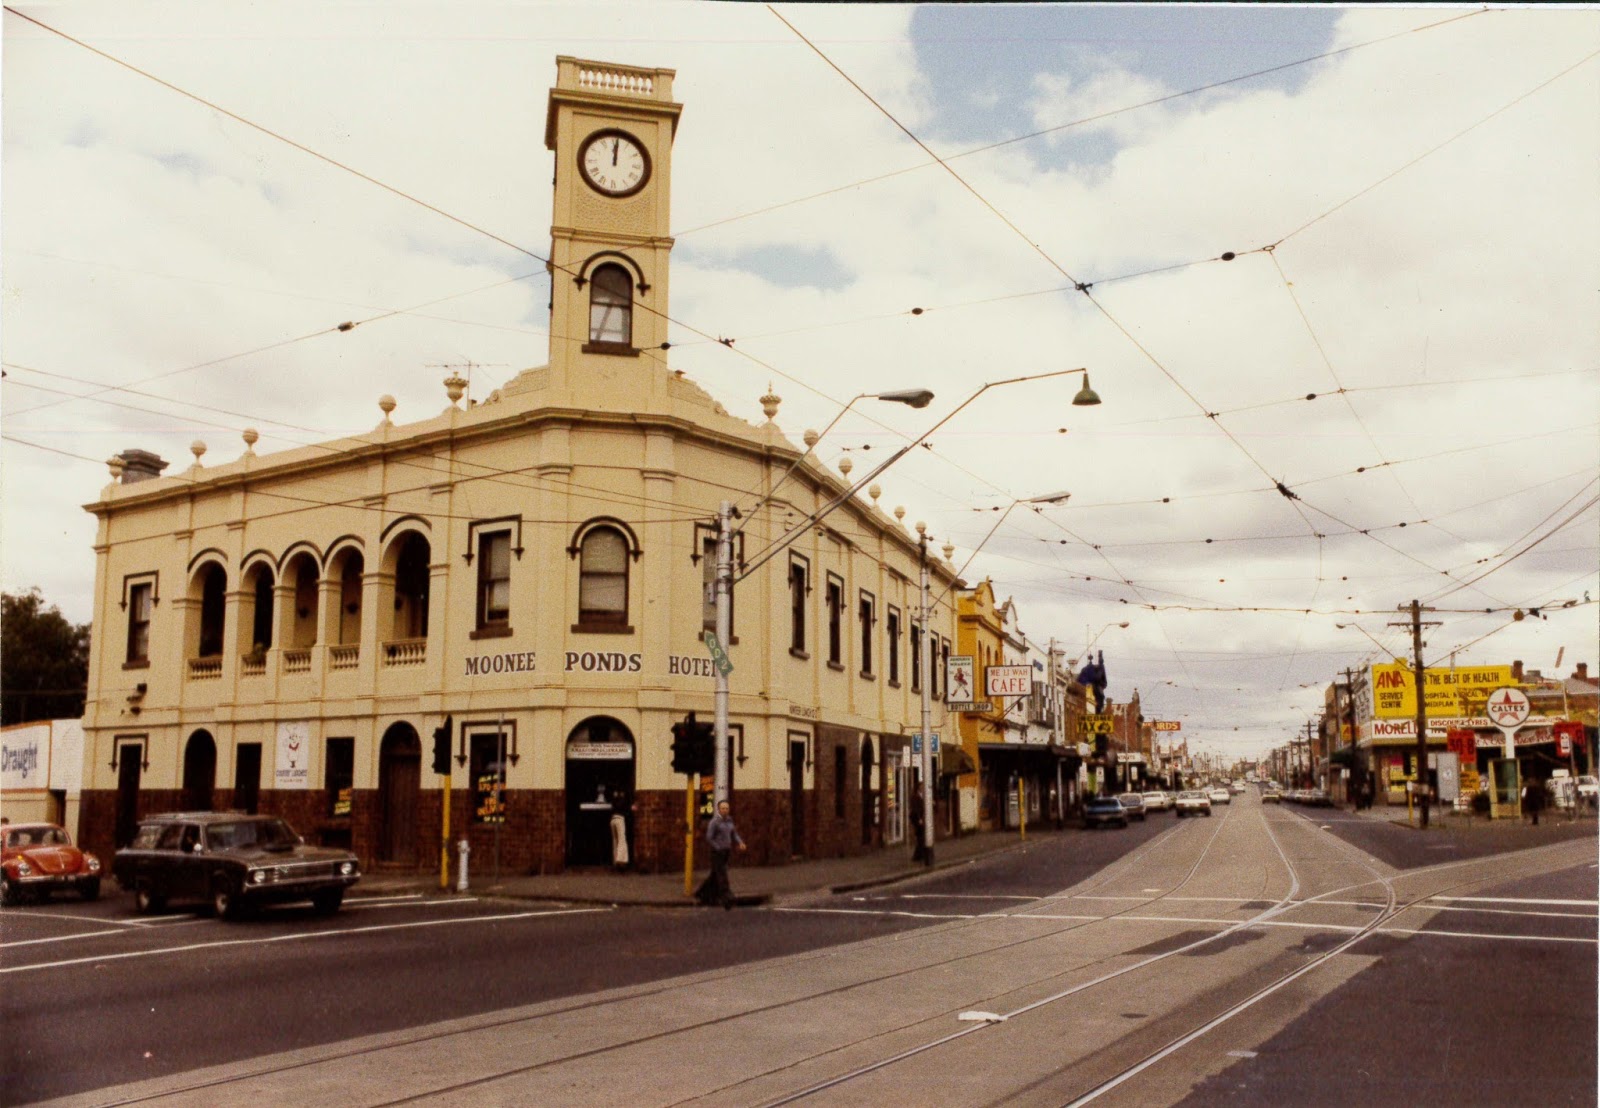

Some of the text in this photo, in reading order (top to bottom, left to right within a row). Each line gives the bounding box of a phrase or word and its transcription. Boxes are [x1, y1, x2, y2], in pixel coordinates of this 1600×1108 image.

[465, 652, 536, 675] MOONEE
[565, 652, 642, 672] PONDS
[991, 678, 1027, 692] CAFE
[1376, 670, 1406, 689] ANA
[1430, 674, 1441, 685] THE
[1444, 674, 1460, 684] BEST
[1463, 673, 1471, 683] OF
[1474, 672, 1500, 682] HEALTH
[1380, 692, 1404, 700] SERVICE
[1077, 721, 1095, 732] TAX
[1, 743, 37, 779] Draught
